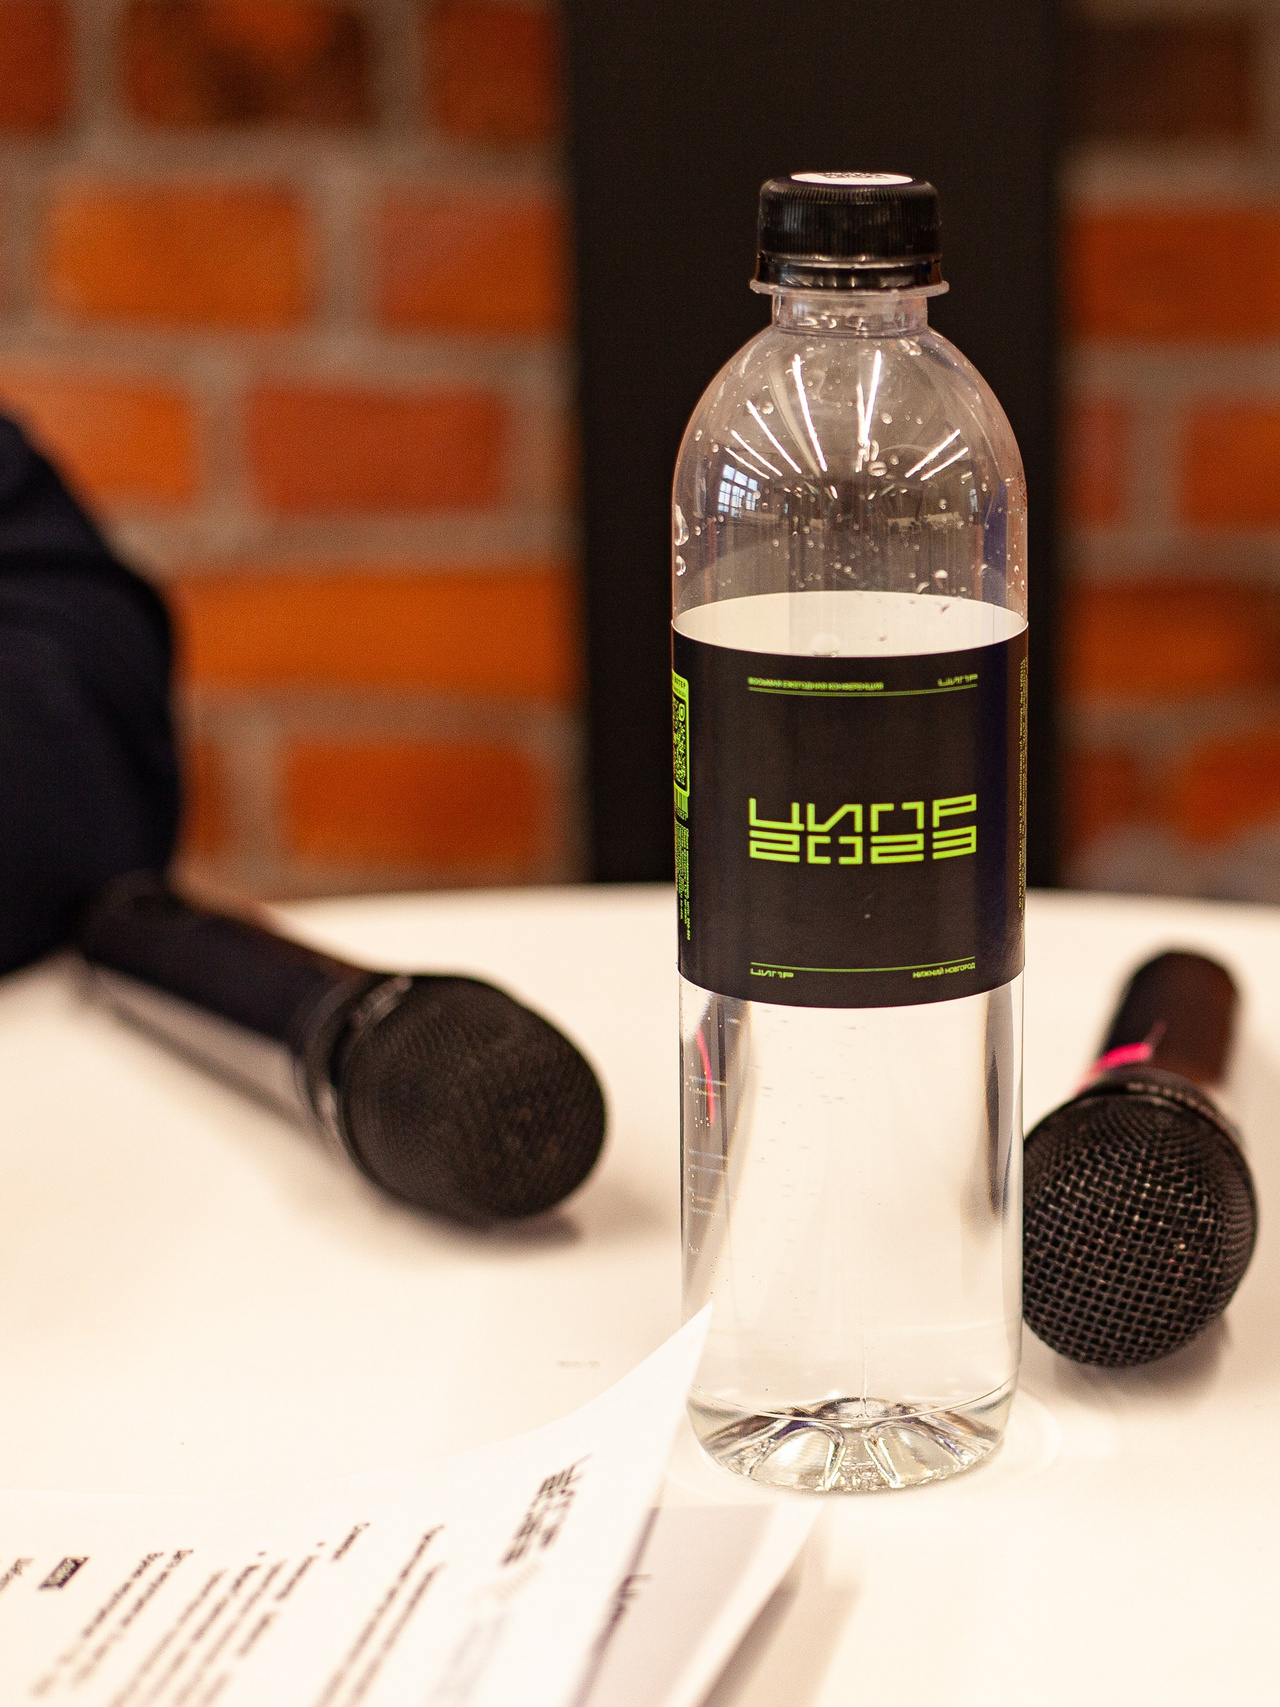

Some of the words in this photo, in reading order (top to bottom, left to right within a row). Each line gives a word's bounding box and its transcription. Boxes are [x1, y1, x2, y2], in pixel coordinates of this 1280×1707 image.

[938, 673, 979, 687] ЦИПР
[749, 794, 977, 833] ЦИПР
[749, 825, 977, 865] 2023
[750, 968, 795, 979] ЦИПР
[912, 966, 944, 979] НИЖНИЙ
[944, 962, 976, 975] НОВГОРОД
